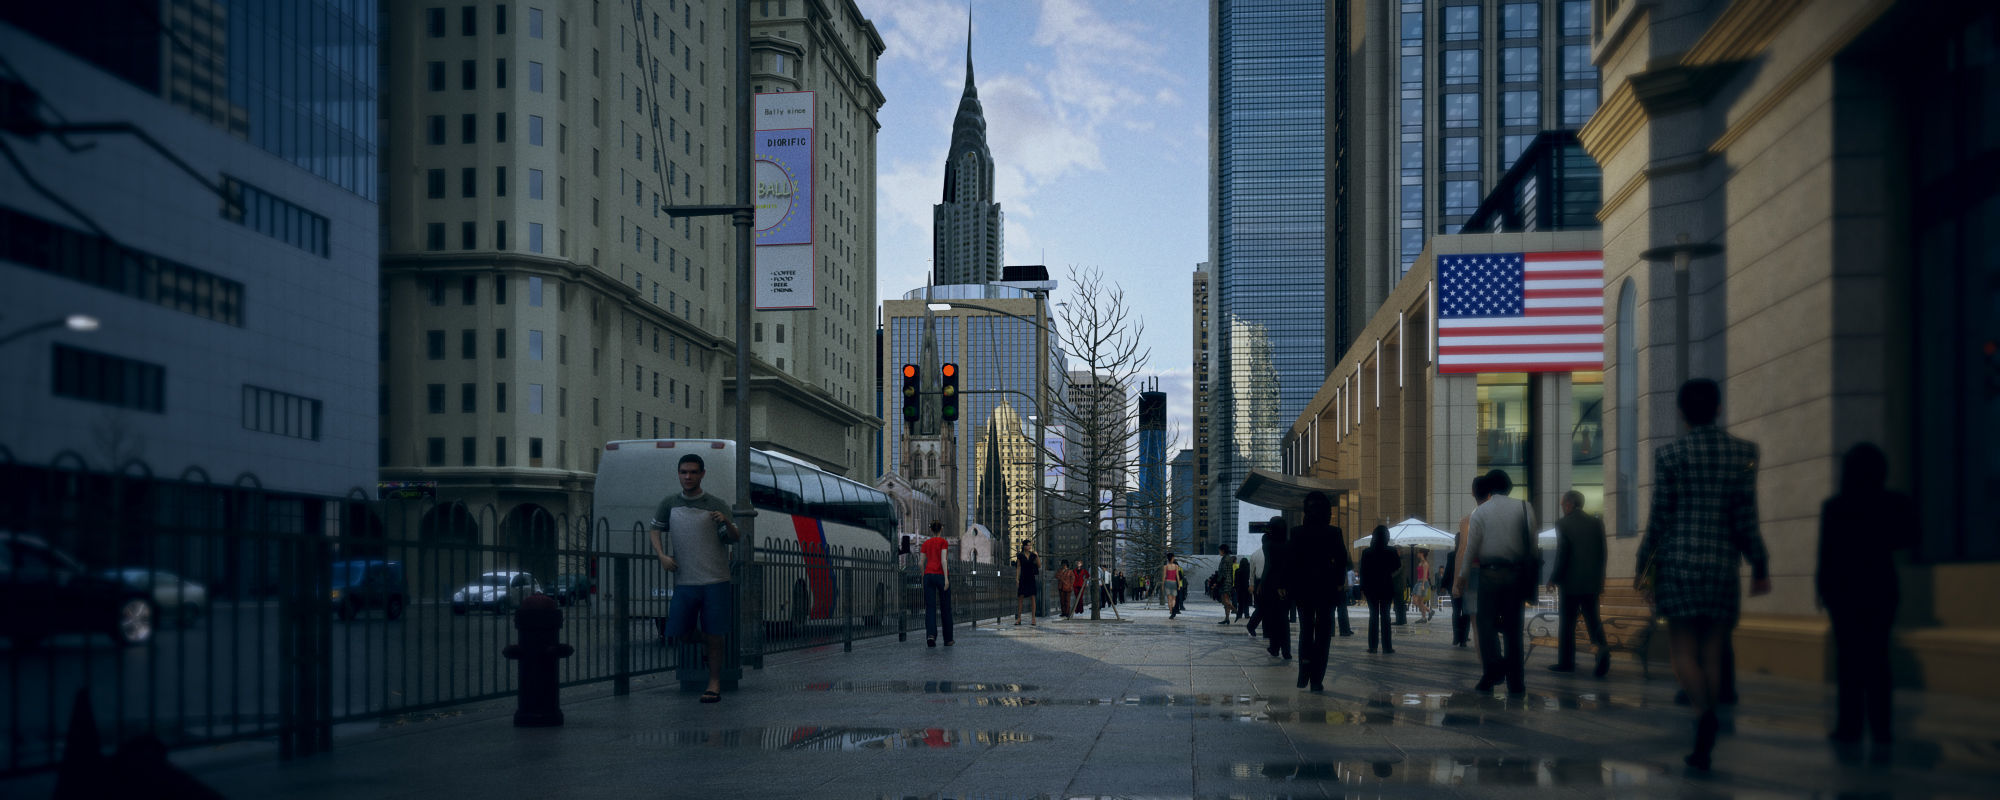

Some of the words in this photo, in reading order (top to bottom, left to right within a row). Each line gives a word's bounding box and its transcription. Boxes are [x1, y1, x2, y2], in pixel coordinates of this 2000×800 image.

[764, 108, 784, 116] Bally
[767, 138, 806, 147] DIORIFIC
[758, 180, 798, 197] BALLY
